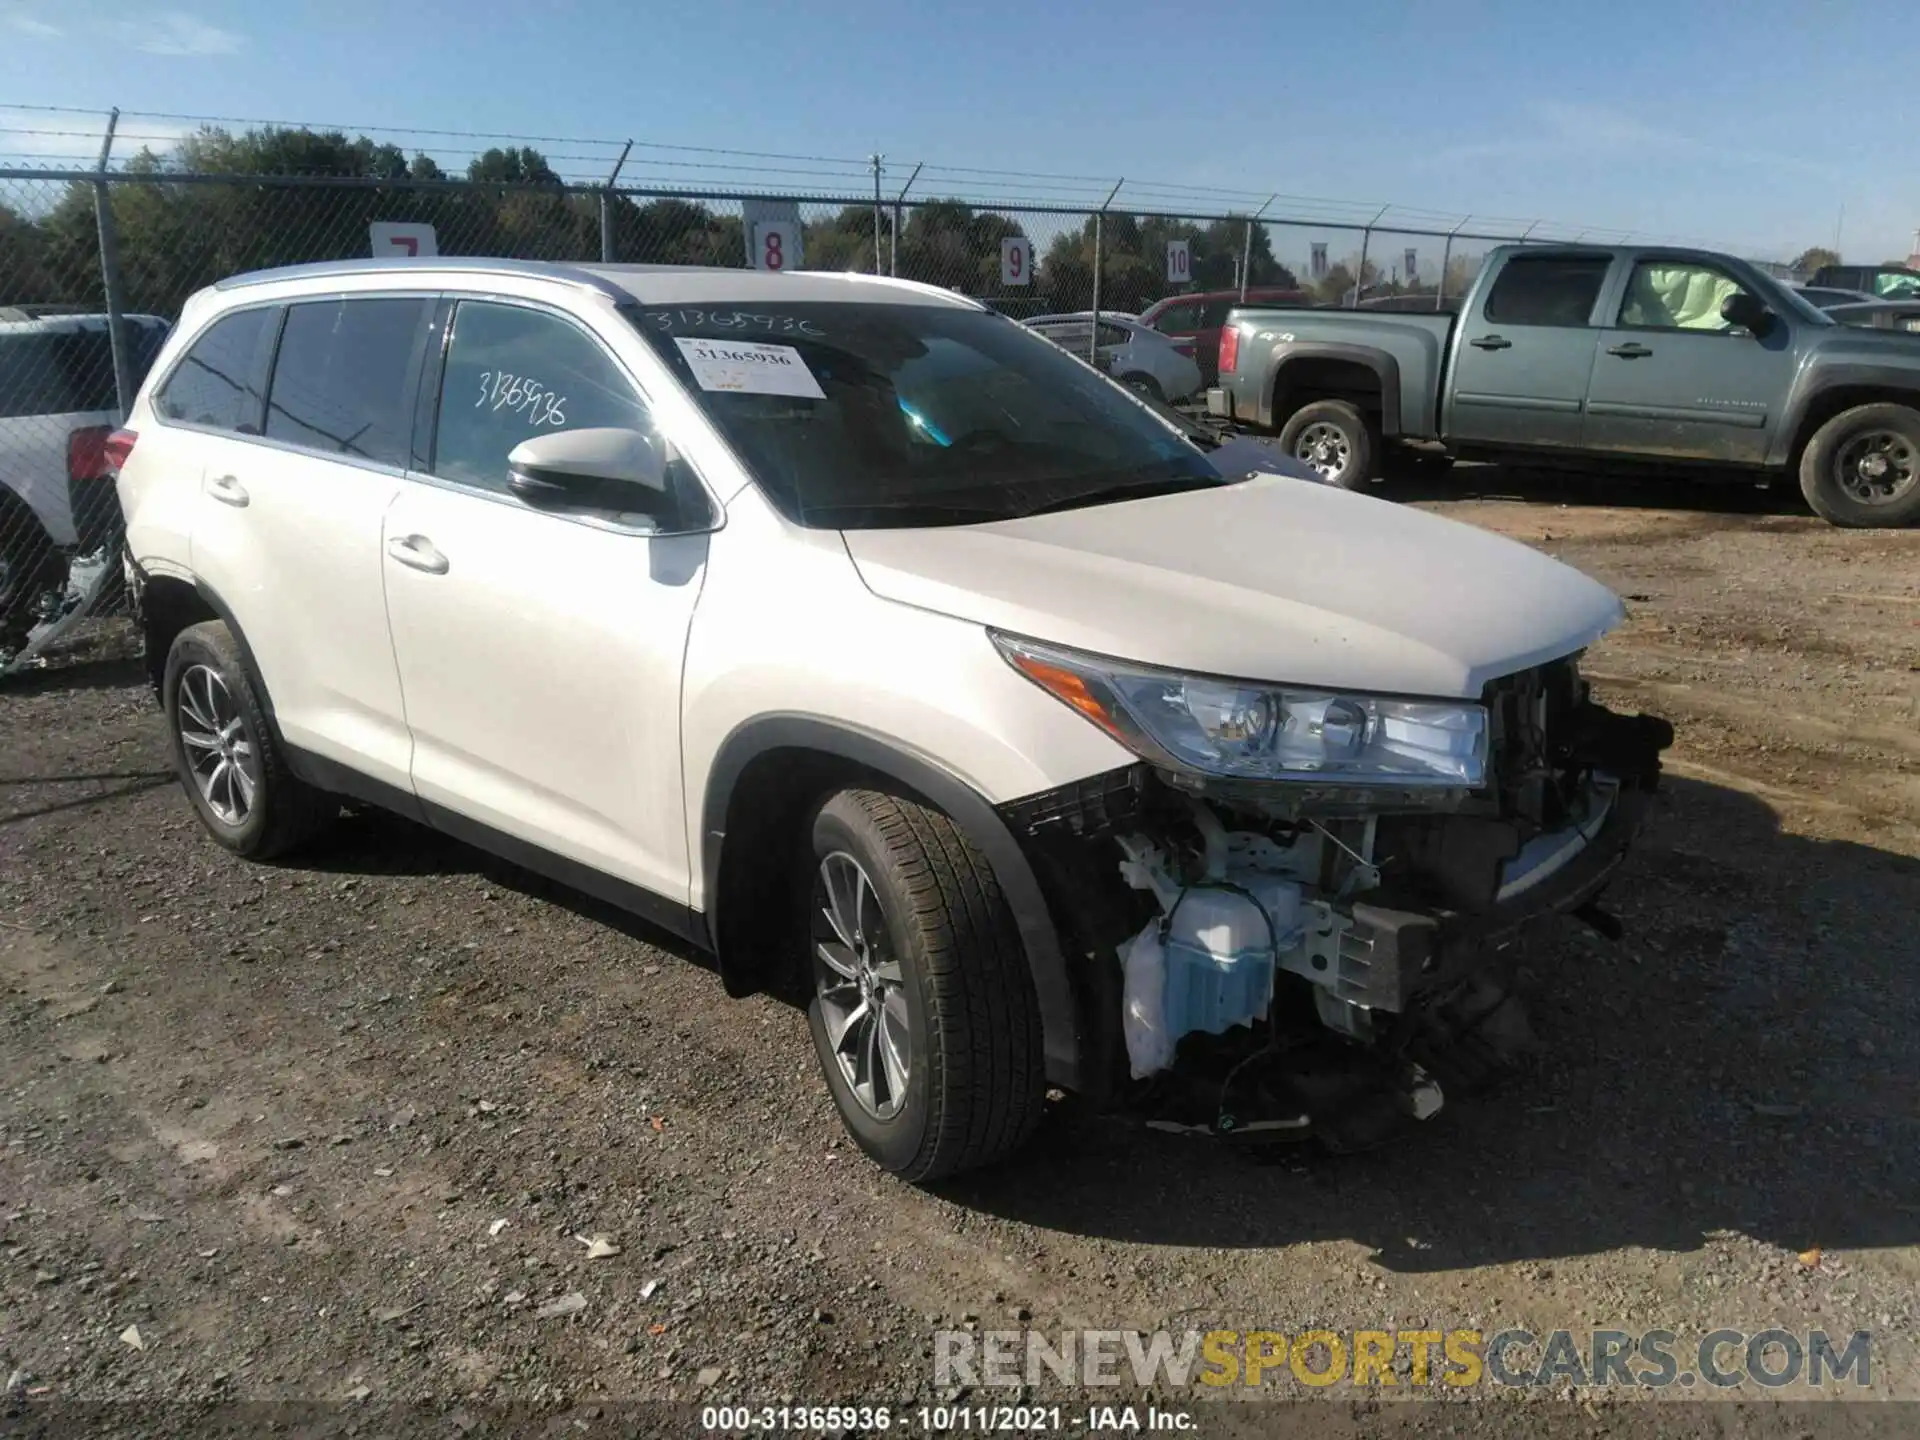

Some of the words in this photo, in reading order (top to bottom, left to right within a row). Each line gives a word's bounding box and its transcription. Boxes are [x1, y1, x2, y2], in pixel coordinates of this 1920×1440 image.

[765, 231, 783, 270] 8
[1010, 246, 1022, 277] 9
[1170, 249, 1187, 274] 10
[694, 347, 792, 366] 31365936
